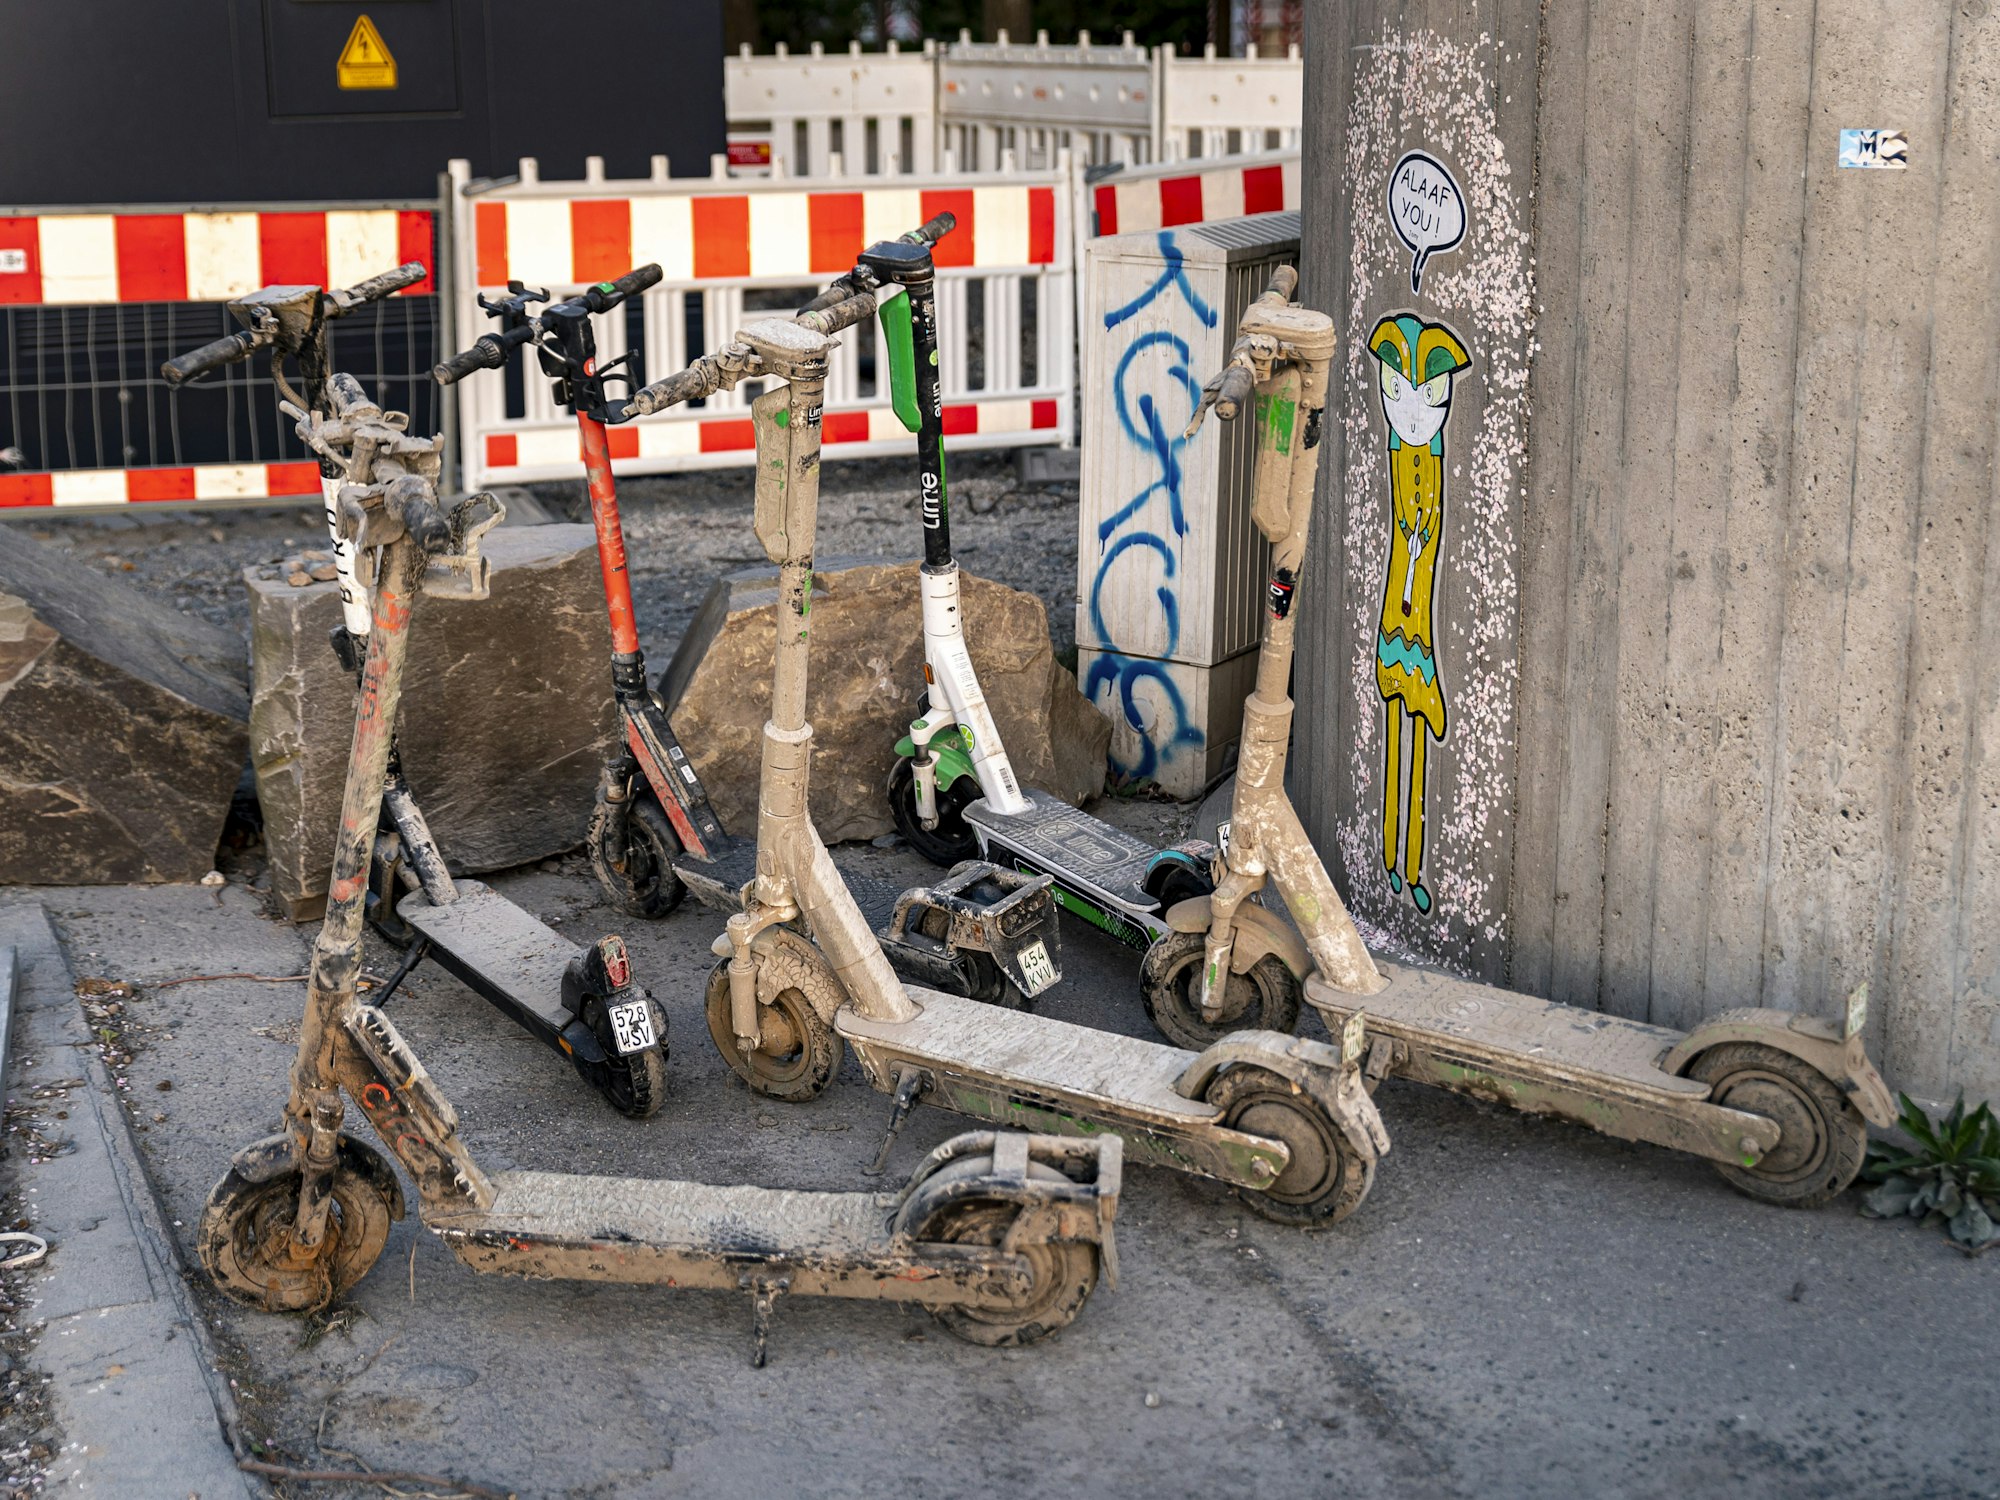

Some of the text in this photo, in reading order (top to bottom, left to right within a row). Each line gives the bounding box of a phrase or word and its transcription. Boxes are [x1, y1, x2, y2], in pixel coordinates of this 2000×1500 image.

[1400, 167, 1451, 208] ALAAF
[921, 472, 940, 529] Lime
[1024, 946, 1045, 970] 454
[1028, 964, 1051, 989] KYV
[615, 1006, 646, 1028] 528
[619, 1026, 650, 1047] WSV
